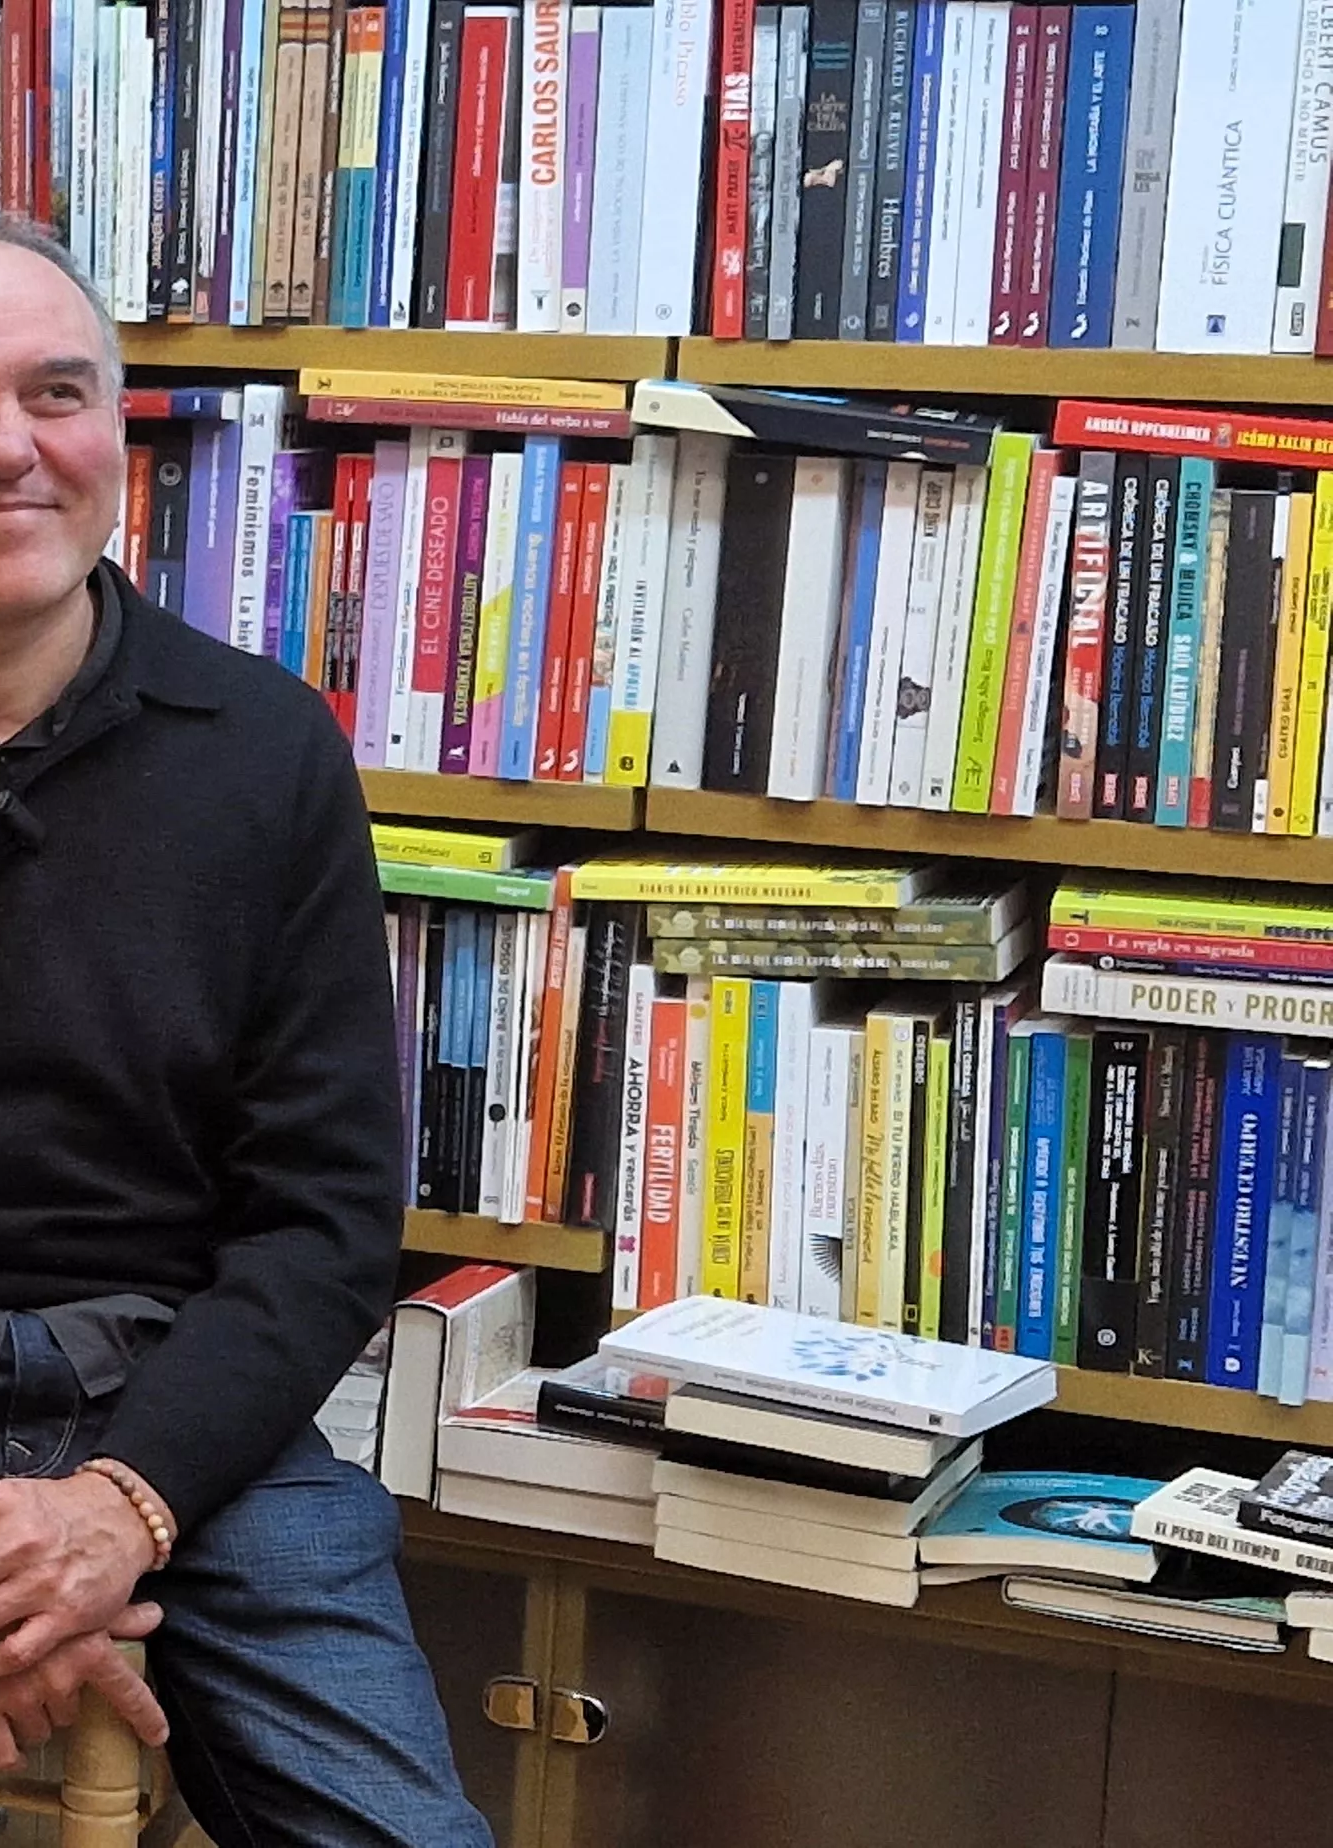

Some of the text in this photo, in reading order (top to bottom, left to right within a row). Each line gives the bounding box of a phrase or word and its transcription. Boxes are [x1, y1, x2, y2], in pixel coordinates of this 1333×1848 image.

[673, 39, 698, 108] Picasso
[891, 10, 909, 87] RICHARD
[1301, 10, 1319, 81] DERECHO
[1091, 80, 1104, 92] EL
[1298, 99, 1312, 123] NO
[530, 80, 558, 185] CARLOS
[885, 110, 903, 172] REEVES
[1309, 81, 1333, 165] CAMUS
[1085, 158, 1098, 173] LA
[1208, 119, 1244, 286] FÍSICA CUÁNTICA
[876, 197, 900, 279] Hombres
[240, 464, 266, 578] Feminismos
[1116, 476, 1139, 538] CRÓNICA
[1150, 478, 1171, 541] CRÓNICA
[420, 495, 450, 656] EL CINE DESEADO
[1071, 479, 1110, 650] ARTIFICIAL
[1115, 560, 1134, 581] UN
[1116, 540, 1136, 560] DE
[1148, 561, 1166, 583] UN
[238, 595, 256, 615] La
[519, 593, 540, 648] noches
[1112, 581, 1133, 645] FRACASO
[1144, 583, 1166, 648] FRACASO
[1166, 481, 1203, 742] CHOMSKY & SAÚL ALVÍDREZ
[517, 650, 532, 671] en
[1106, 933, 1256, 961] La regla es sagrada
[1130, 982, 1218, 1017] PODER
[1226, 999, 1238, 1013] Y
[913, 1033, 926, 1086] CEREBRO
[625, 1057, 644, 1138] AHORRA
[891, 1122, 904, 1143] TU
[622, 1156, 639, 1223] vencerás
[648, 1123, 677, 1224] FERTILIDAD
[889, 1144, 902, 1189] PERRO
[1229, 1112, 1259, 1290] NUESTRO CUERPO
[1153, 1520, 1282, 1564] EL PESO DEL TIEMPO
